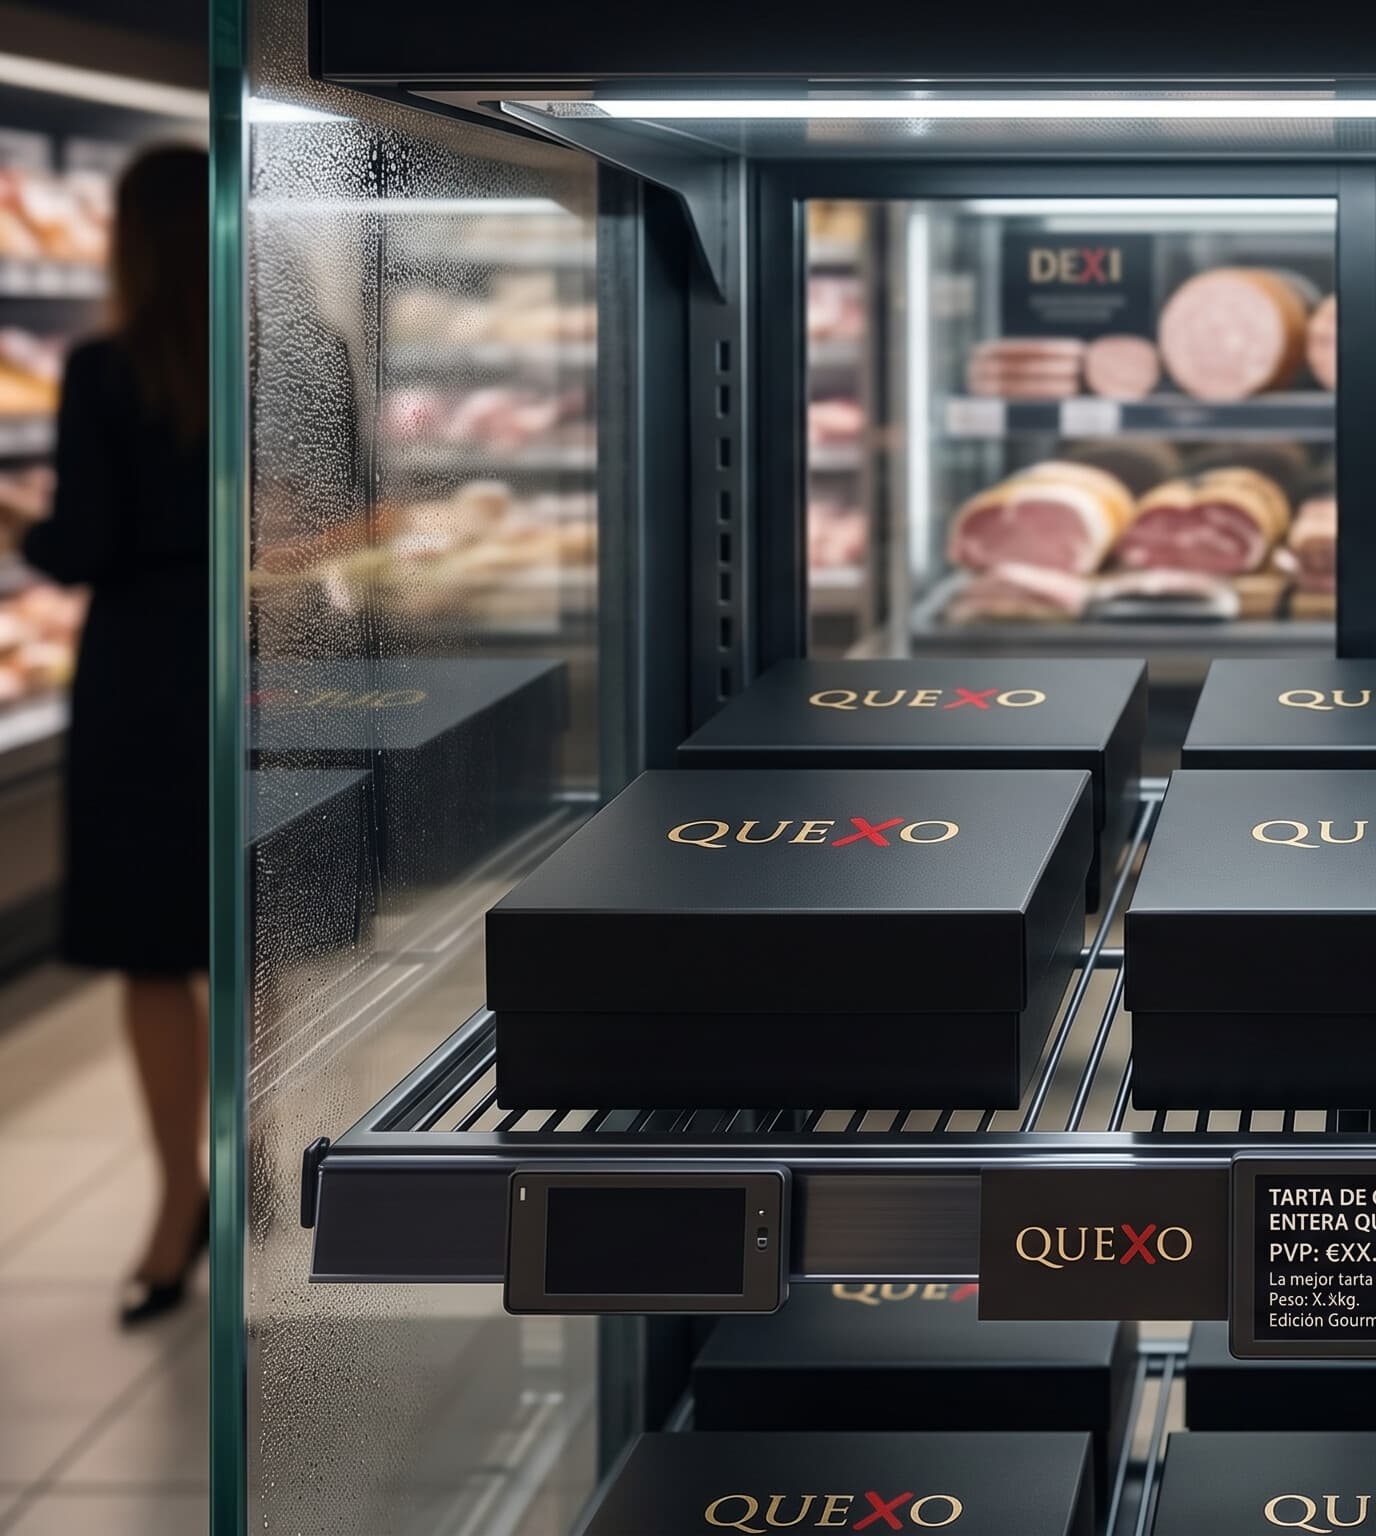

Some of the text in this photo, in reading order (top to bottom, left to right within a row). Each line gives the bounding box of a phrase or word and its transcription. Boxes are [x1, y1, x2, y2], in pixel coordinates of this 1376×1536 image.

[1028, 247, 1123, 284] DEXI
[809, 687, 1044, 711] QUEXO
[666, 816, 959, 848] QUEXO
[1269, 1188, 1333, 1206] TARTA
[1341, 1188, 1366, 1206] DE
[1270, 1213, 1348, 1231] ENTERA
[1014, 1222, 1194, 1269] QUEXO
[1270, 1242, 1318, 1262] PVP:
[1270, 1272, 1285, 1286] La
[1291, 1272, 1334, 1289] mejor
[1339, 1273, 1372, 1286] tarta
[831, 1284, 978, 1306] QUE
[1270, 1292, 1307, 1306] Peso:
[1270, 1313, 1323, 1327] Edición
[704, 1490, 963, 1534] QUEXO
